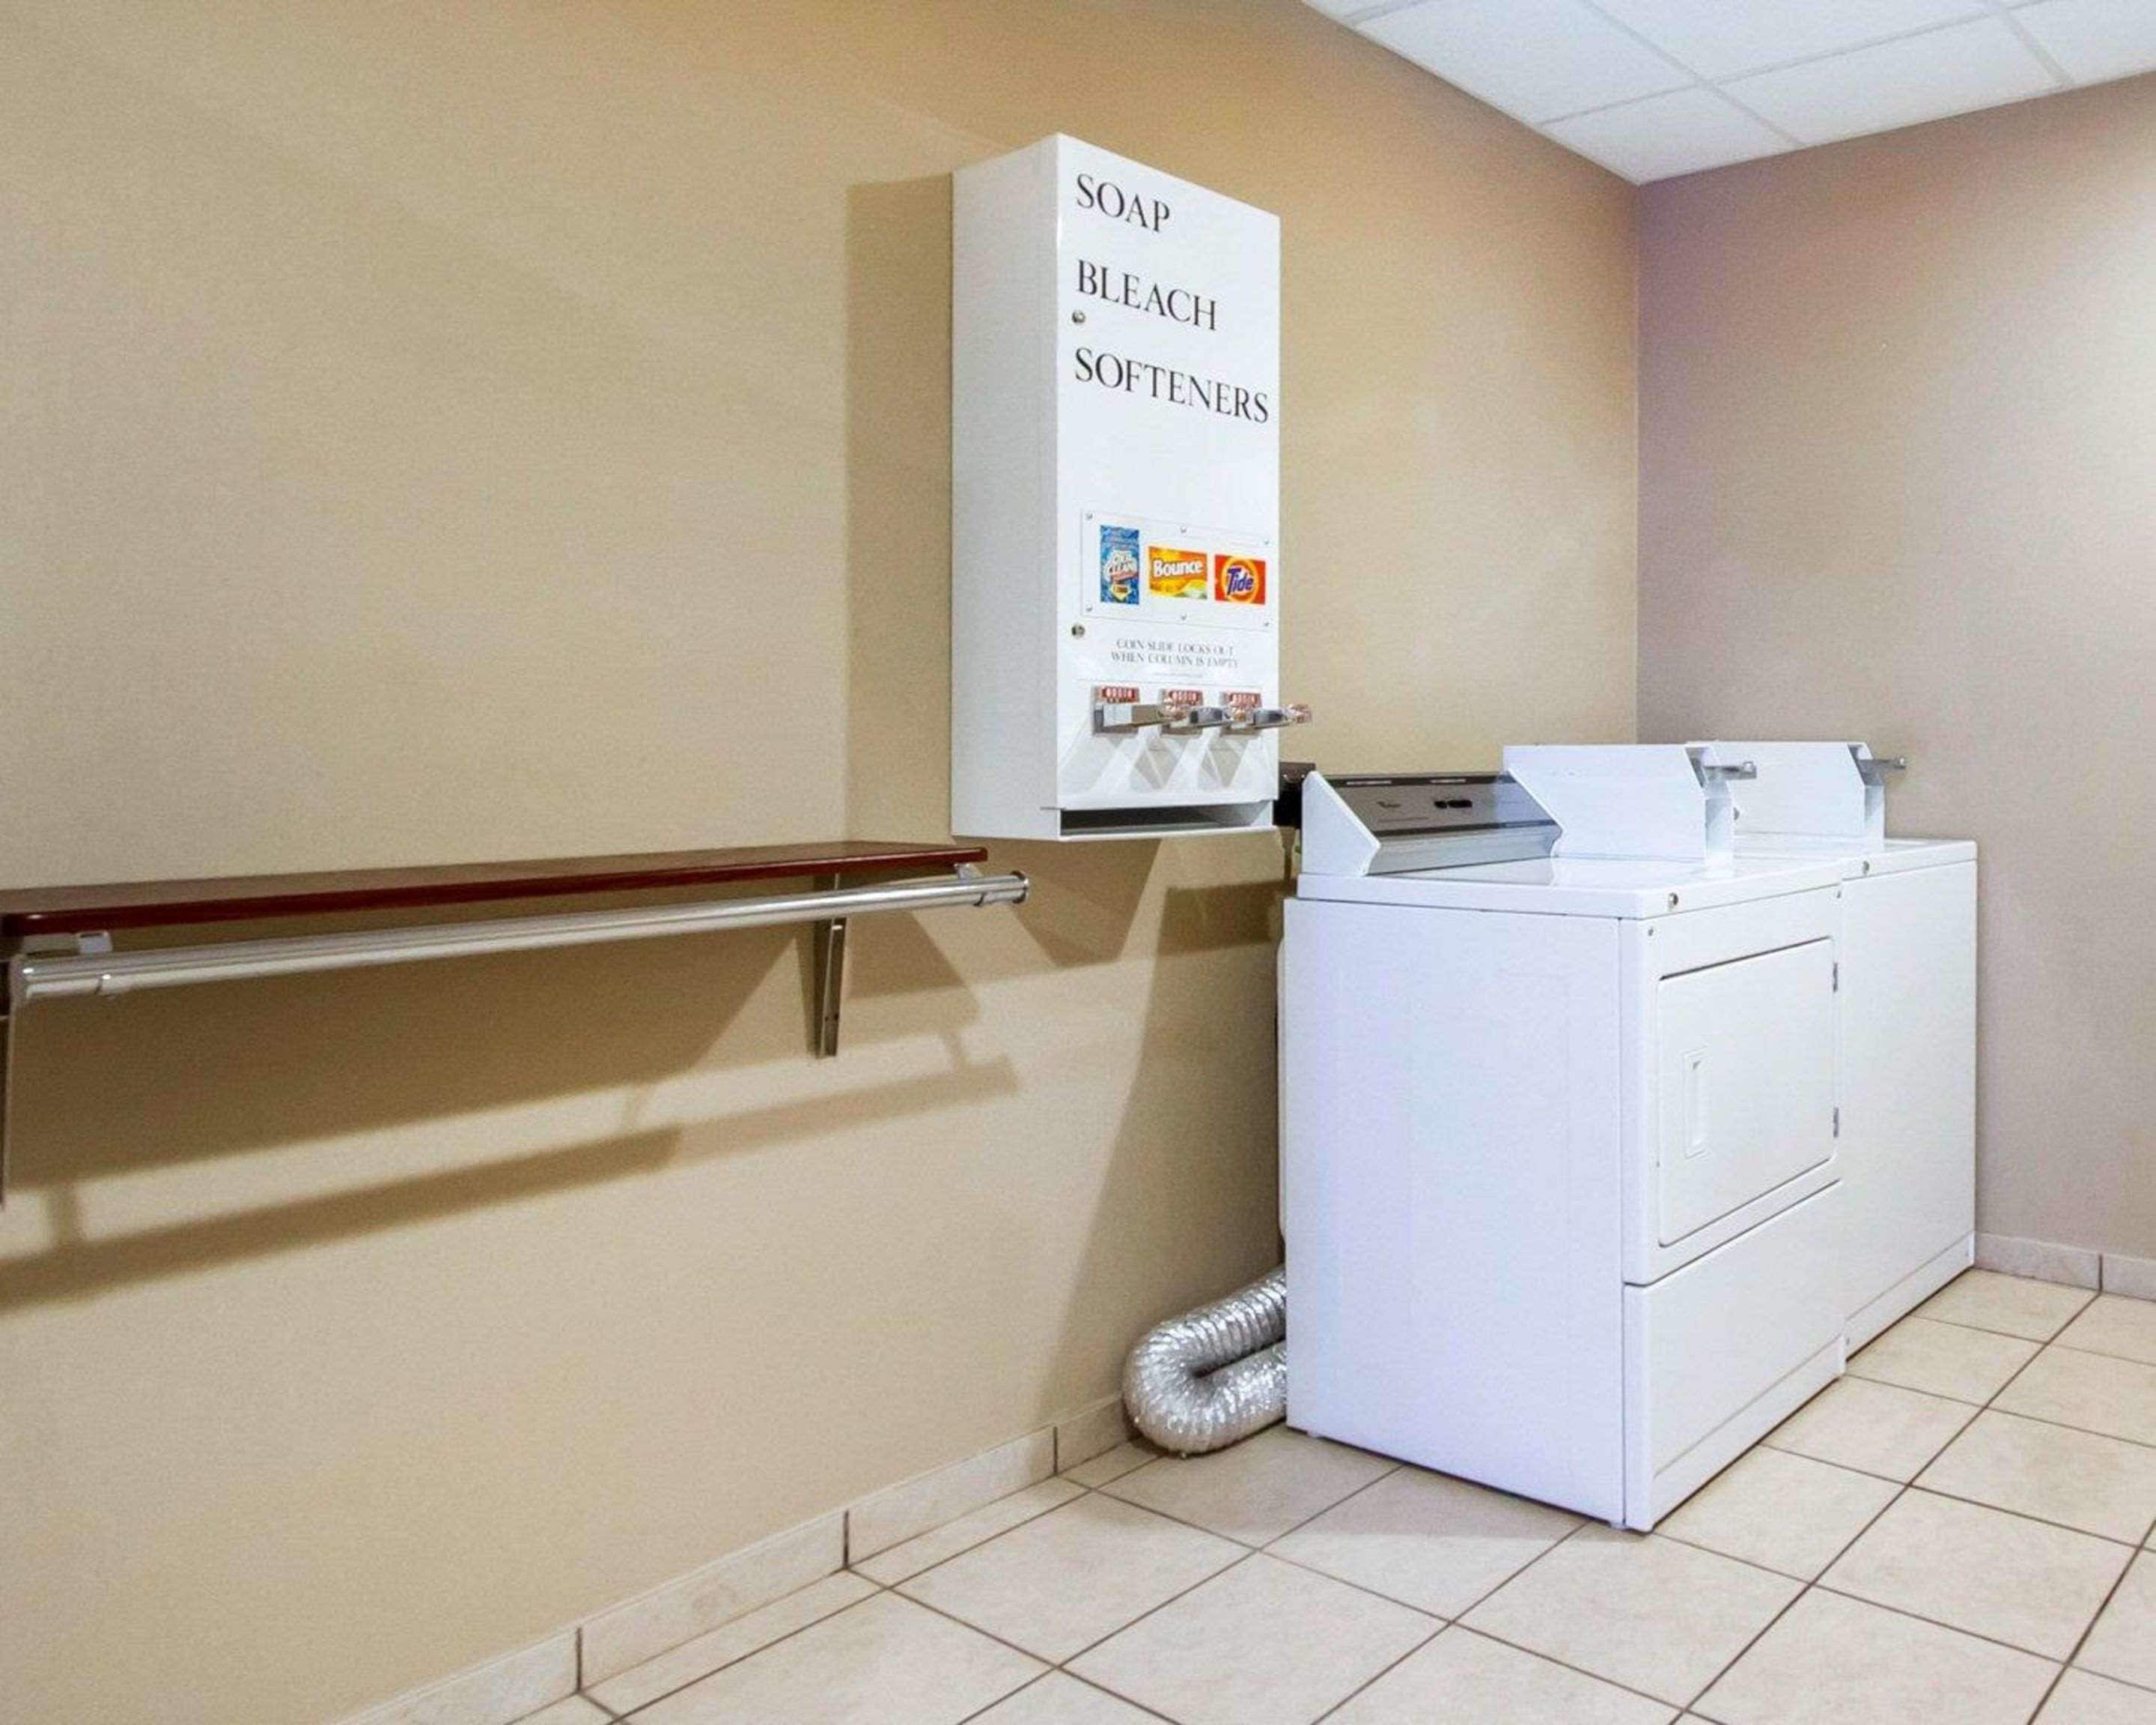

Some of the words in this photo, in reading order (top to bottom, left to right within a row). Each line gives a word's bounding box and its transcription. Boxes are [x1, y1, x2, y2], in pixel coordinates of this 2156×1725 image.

[1077, 173, 1170, 233] SOAP
[1077, 259, 1216, 331] BLEACH
[1074, 347, 1270, 424] SOFTENERS
[1153, 559, 1203, 578] Bounce
[1226, 567, 1255, 596] Tide
[1110, 651, 1145, 663] WHEN
[1148, 653, 1193, 666] COLUMN
[1196, 656, 1204, 666] IS
[1207, 657, 1239, 669] EMPTY
[1116, 638, 1144, 650] COIN
[1148, 640, 1173, 651] SLIDE
[1178, 642, 1211, 654] LOCKS
